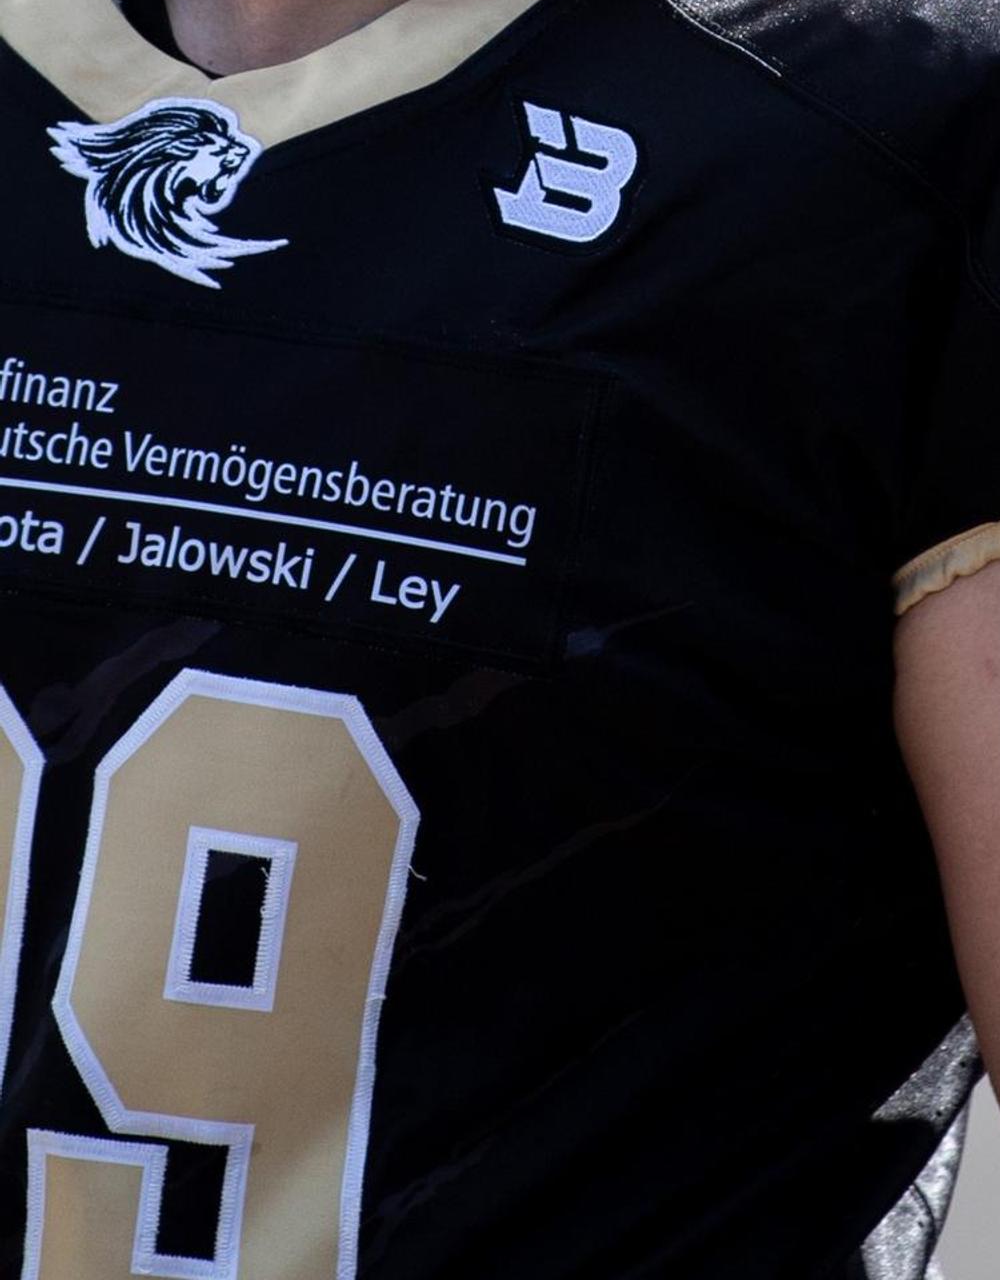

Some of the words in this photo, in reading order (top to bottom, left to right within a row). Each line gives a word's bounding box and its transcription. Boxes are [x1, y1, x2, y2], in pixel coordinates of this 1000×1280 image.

[0, 357, 119, 413] finanz
[123, 431, 536, 548] Vermögensberatung
[76, 516, 107, 565] /
[117, 522, 315, 590] Jalowski
[325, 553, 357, 601] /
[370, 560, 461, 623] Ley
[0, 668, 421, 1280] 9
